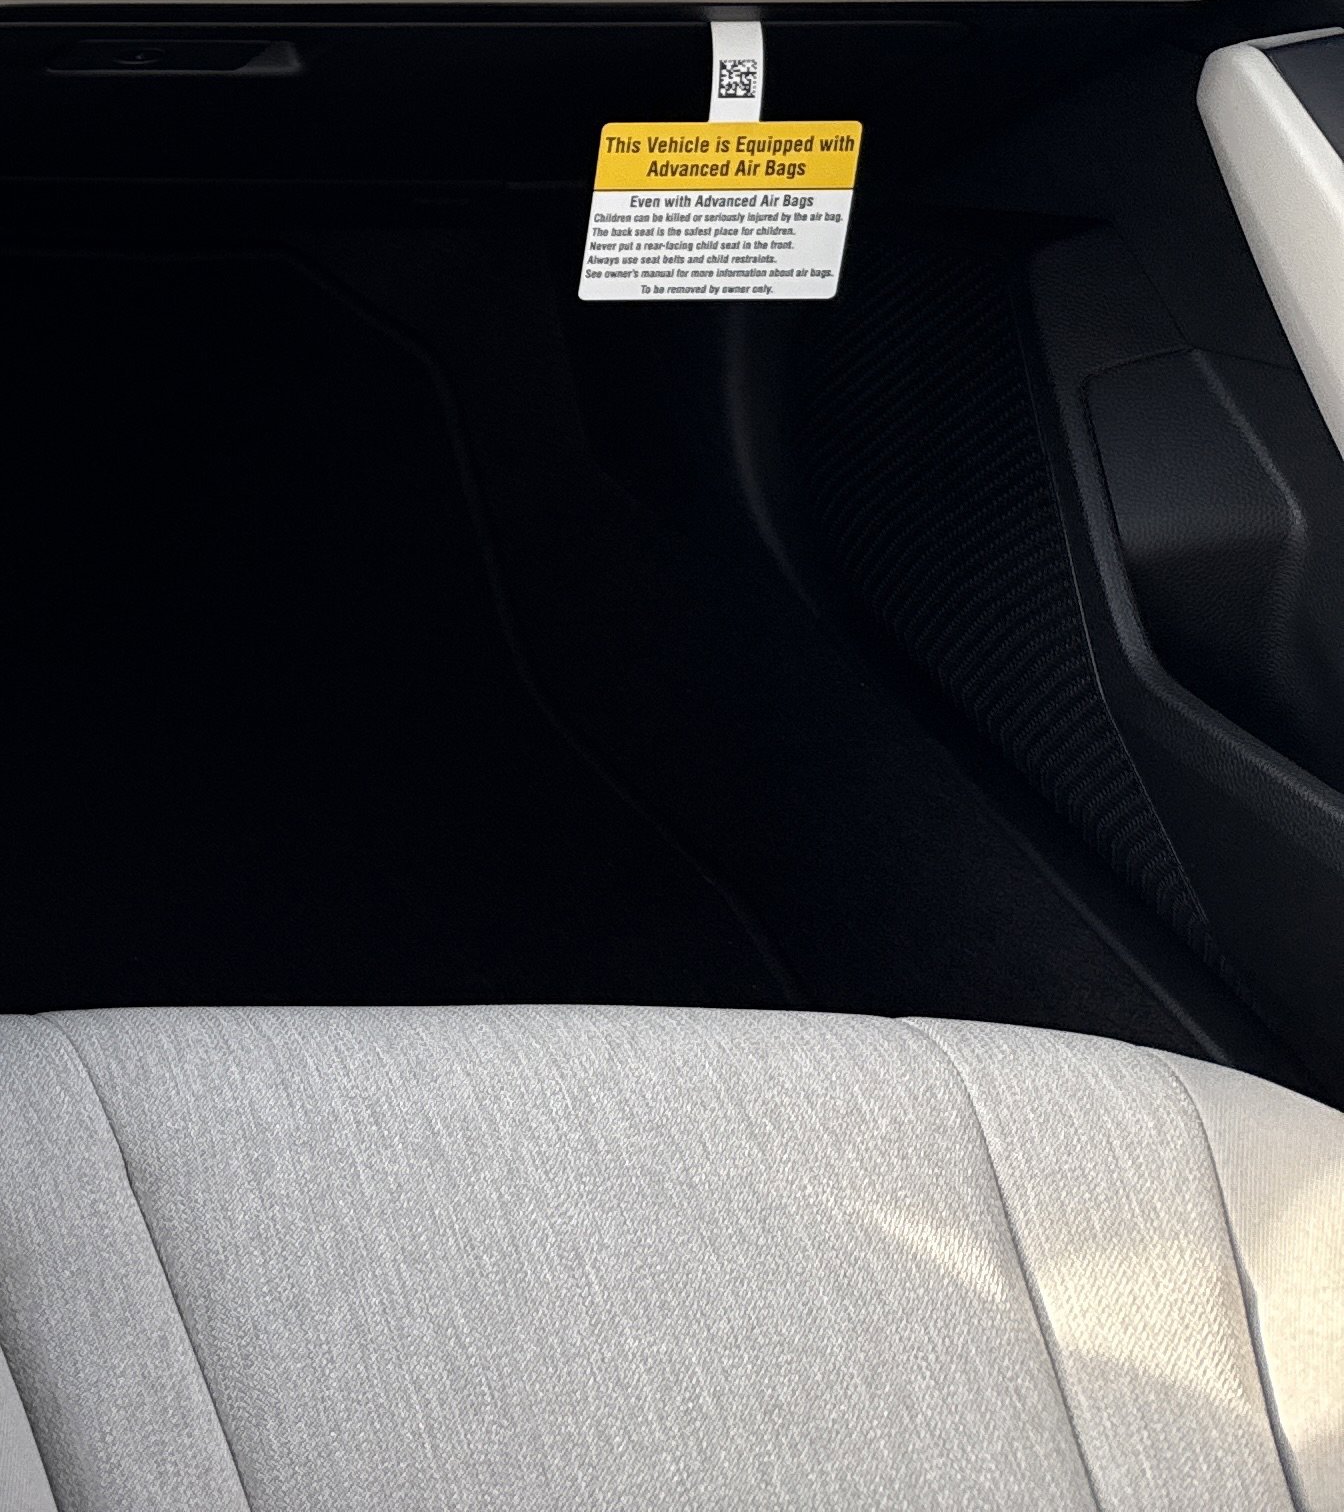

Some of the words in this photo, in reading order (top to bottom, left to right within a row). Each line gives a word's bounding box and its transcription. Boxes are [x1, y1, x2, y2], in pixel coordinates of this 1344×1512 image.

[605, 136, 642, 154] This
[647, 135, 710, 154] Vehicle
[714, 135, 732, 154] is
[735, 135, 815, 157] Equipped
[820, 134, 855, 152] with
[645, 159, 731, 177] Advanced
[734, 159, 761, 177] Air
[764, 159, 807, 180] Bags
[630, 194, 661, 208] Even
[664, 194, 692, 208] with
[694, 194, 758, 208] Advanced
[760, 194, 780, 207] Air
[782, 194, 815, 210] Bags
[593, 213, 632, 223] Children
[633, 214, 650, 223] can
[652, 213, 664, 222] be
[665, 213, 691, 222] killed
[693, 214, 704, 222] or
[704, 212, 746, 223] seriously
[747, 212, 779, 223] injured
[780, 212, 792, 223] by
[793, 212, 808, 222] the
[809, 212, 823, 222] air
[824, 212, 844, 223] bag.
[592, 227, 609, 236] The
[611, 227, 632, 236] back
[634, 227, 656, 236] seat
[657, 227, 665, 236] is
[667, 227, 682, 236] the
[684, 227, 712, 236] safest
[713, 227, 739, 237] place
[741, 226, 754, 236] for
[590, 241, 617, 250] Never
[618, 242, 634, 251] put
[643, 241, 694, 251] rear-facing
[696, 241, 719, 250] child
[720, 241, 740, 250] seat
[742, 241, 752, 249] in
[754, 241, 768, 249] the
[587, 255, 620, 266] Always
[640, 255, 661, 264] seat
[662, 255, 685, 264] belts
[687, 255, 705, 264] and
[706, 255, 729, 264] child
[585, 269, 602, 278] See
[604, 269, 639, 278] owner's
[641, 269, 675, 278] manual
[676, 269, 690, 278] for
[691, 270, 714, 278] more
[716, 268, 767, 278] information
[769, 268, 795, 278] about
[796, 268, 809, 278] air
[810, 268, 835, 278] bags.
[641, 284, 651, 294] To
[653, 284, 665, 294] be
[666, 284, 707, 294] removed
[708, 285, 721, 295] by
[722, 285, 751, 294] owner
